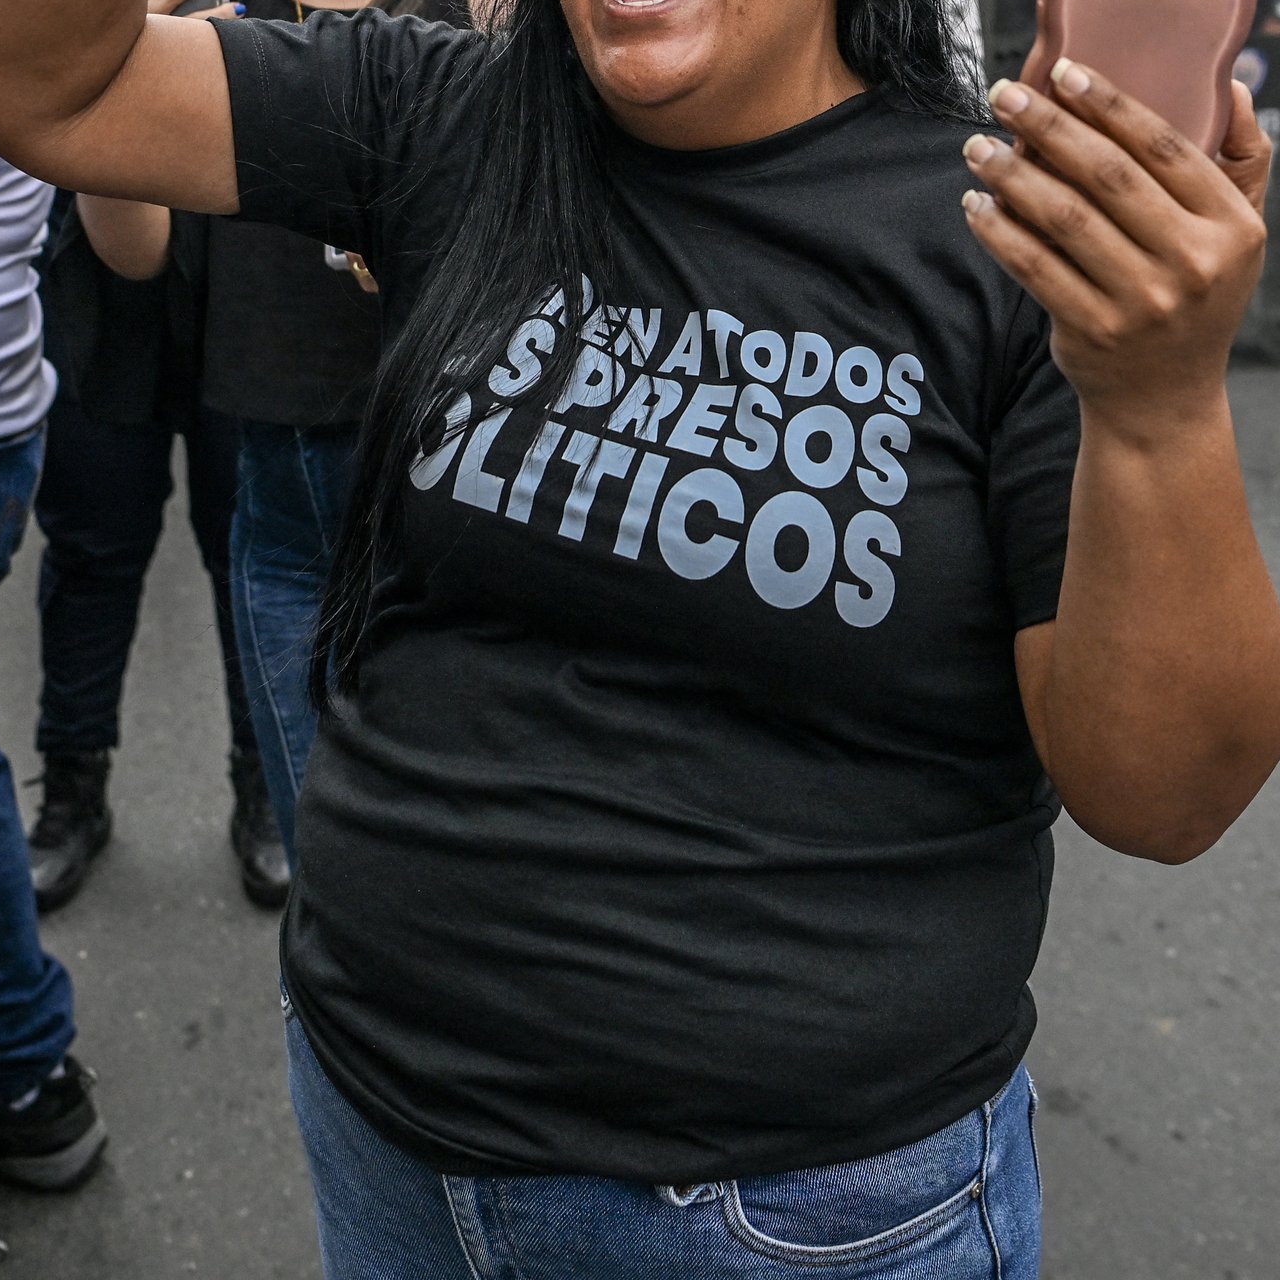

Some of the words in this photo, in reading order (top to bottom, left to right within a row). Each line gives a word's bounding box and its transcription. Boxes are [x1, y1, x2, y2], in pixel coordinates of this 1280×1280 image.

[546, 344, 911, 506] PRESOS
[662, 310, 704, 376] A
[704, 307, 925, 415] TODOS
[408, 390, 902, 628] OLITICOS
